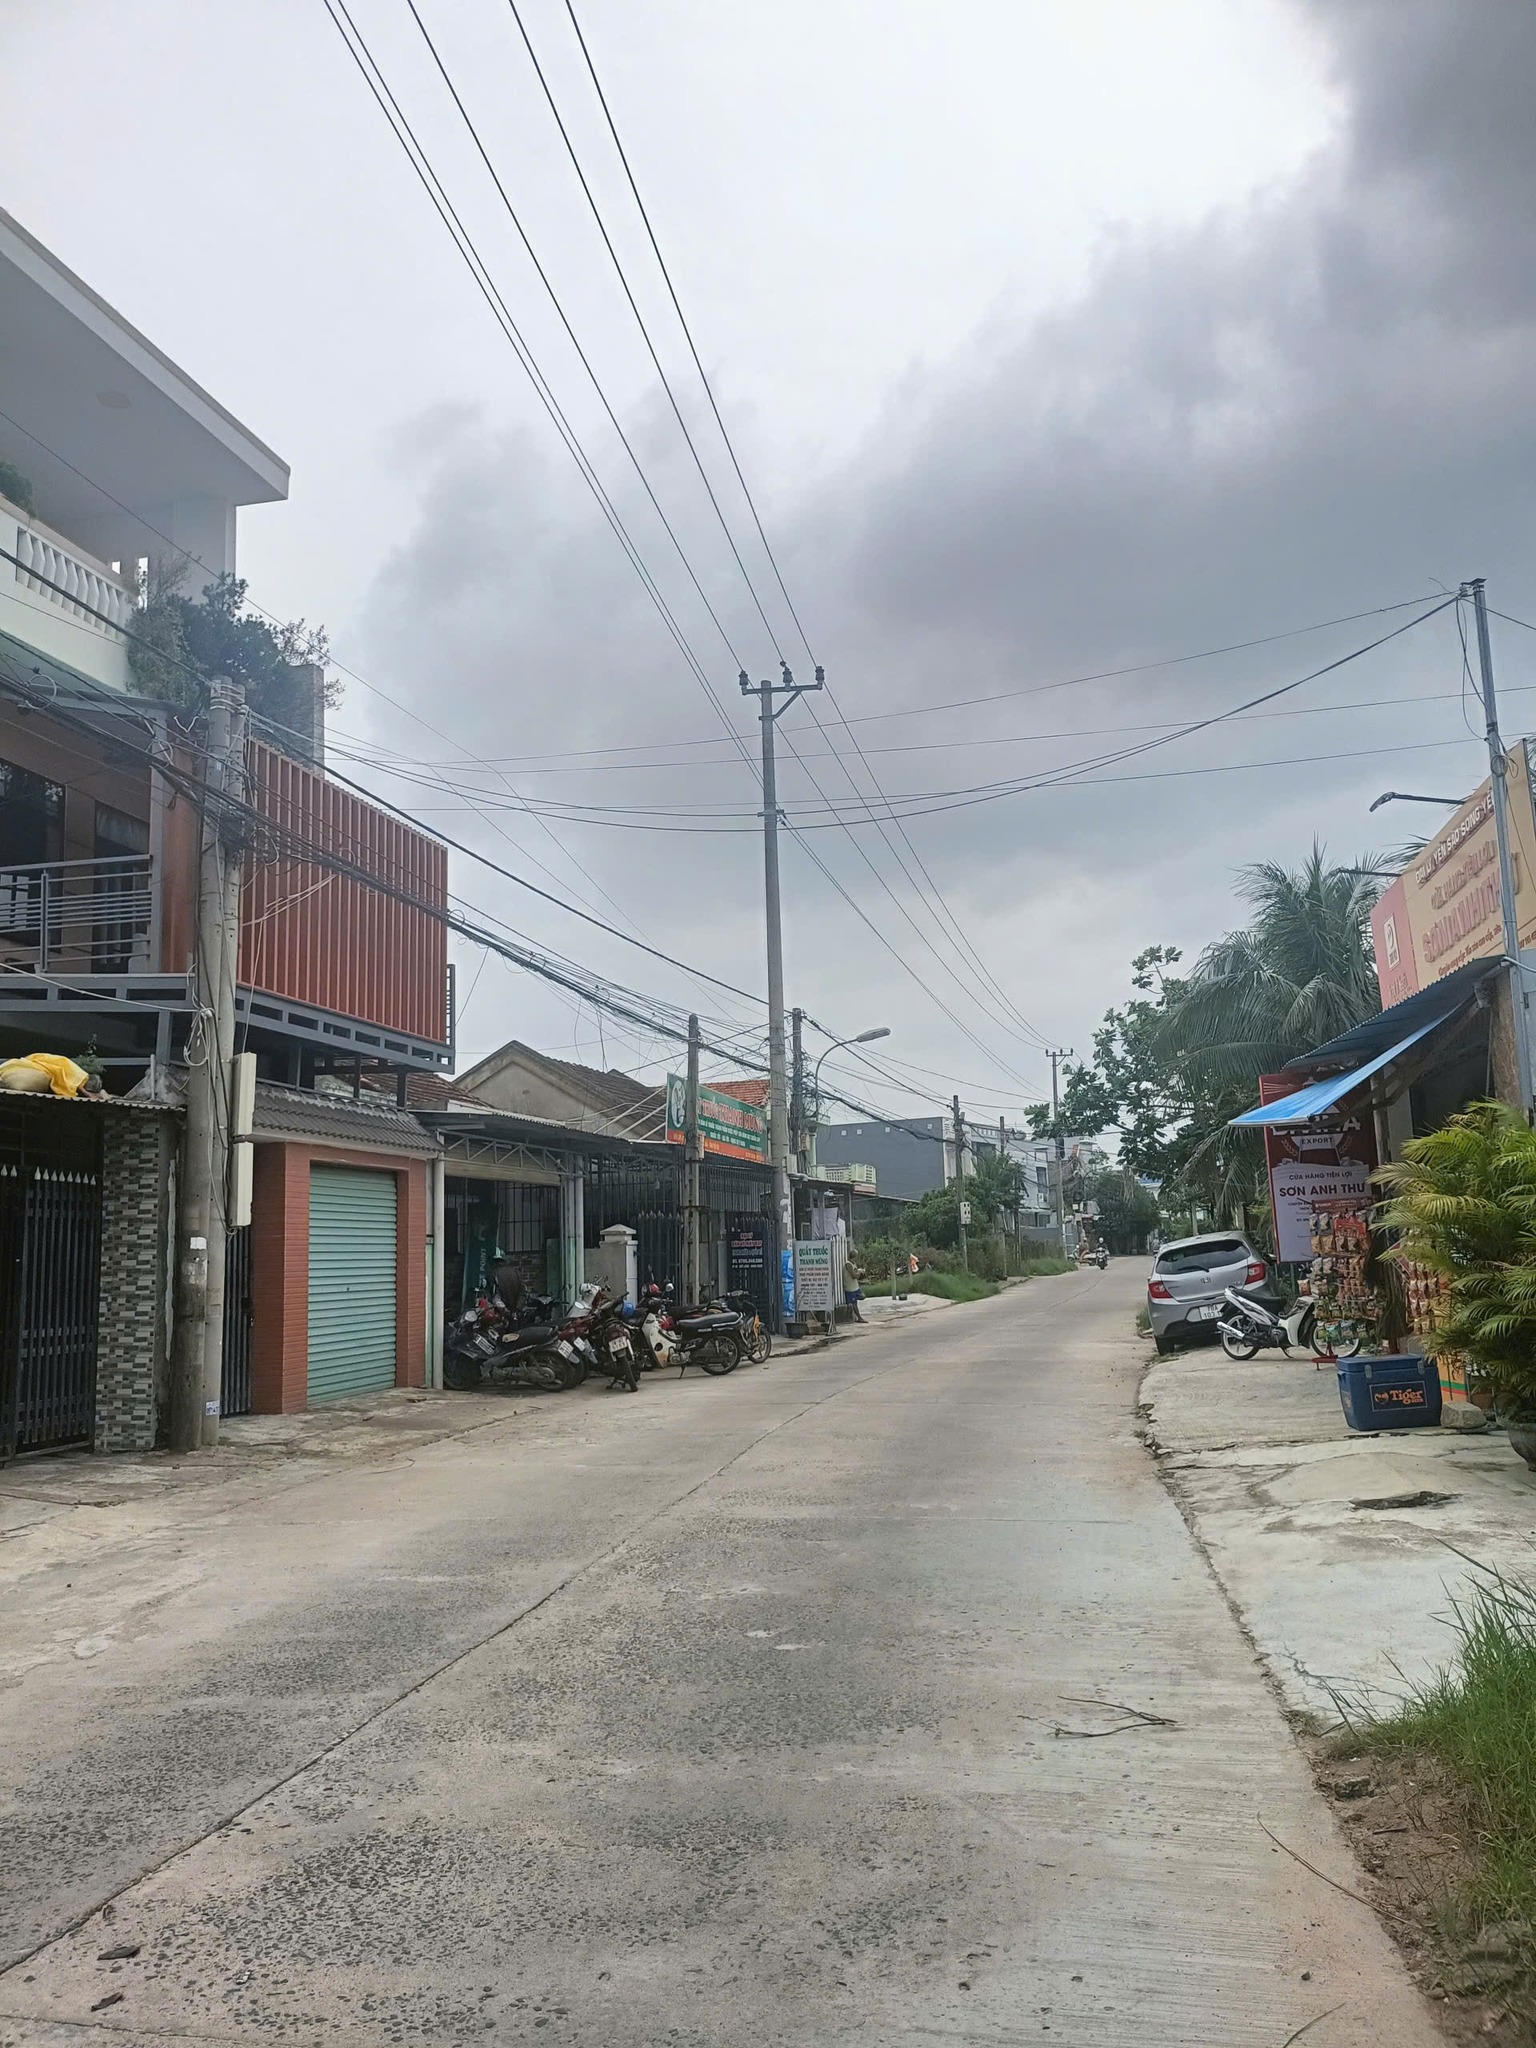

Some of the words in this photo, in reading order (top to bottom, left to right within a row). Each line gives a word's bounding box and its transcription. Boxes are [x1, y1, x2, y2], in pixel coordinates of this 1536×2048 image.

[1279, 1185, 1306, 1197] SƠN
[1310, 1184, 1337, 1195] ANH
[1341, 1181, 1366, 1193] THƯ
[1390, 1389, 1423, 1404] Tiger
